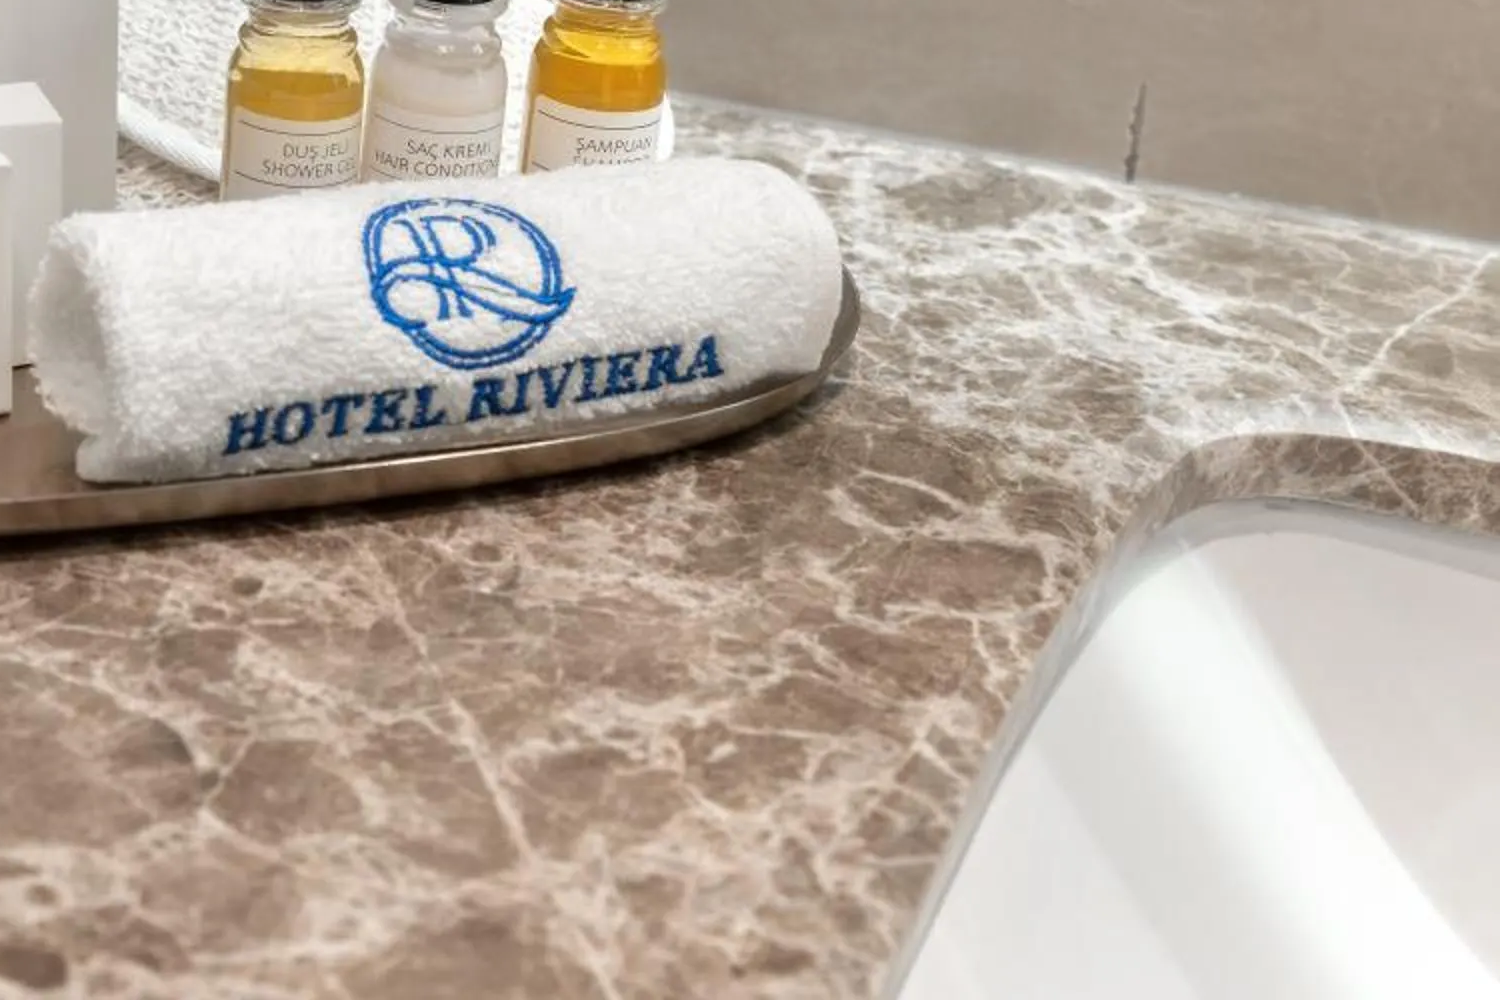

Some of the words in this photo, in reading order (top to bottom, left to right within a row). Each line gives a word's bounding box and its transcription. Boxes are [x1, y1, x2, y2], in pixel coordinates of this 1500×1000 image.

[261, 159, 333, 179] SHOWER
[375, 150, 409, 172] HAIR
[222, 383, 447, 456] HOTEL
[465, 334, 726, 423] RIVIERA
